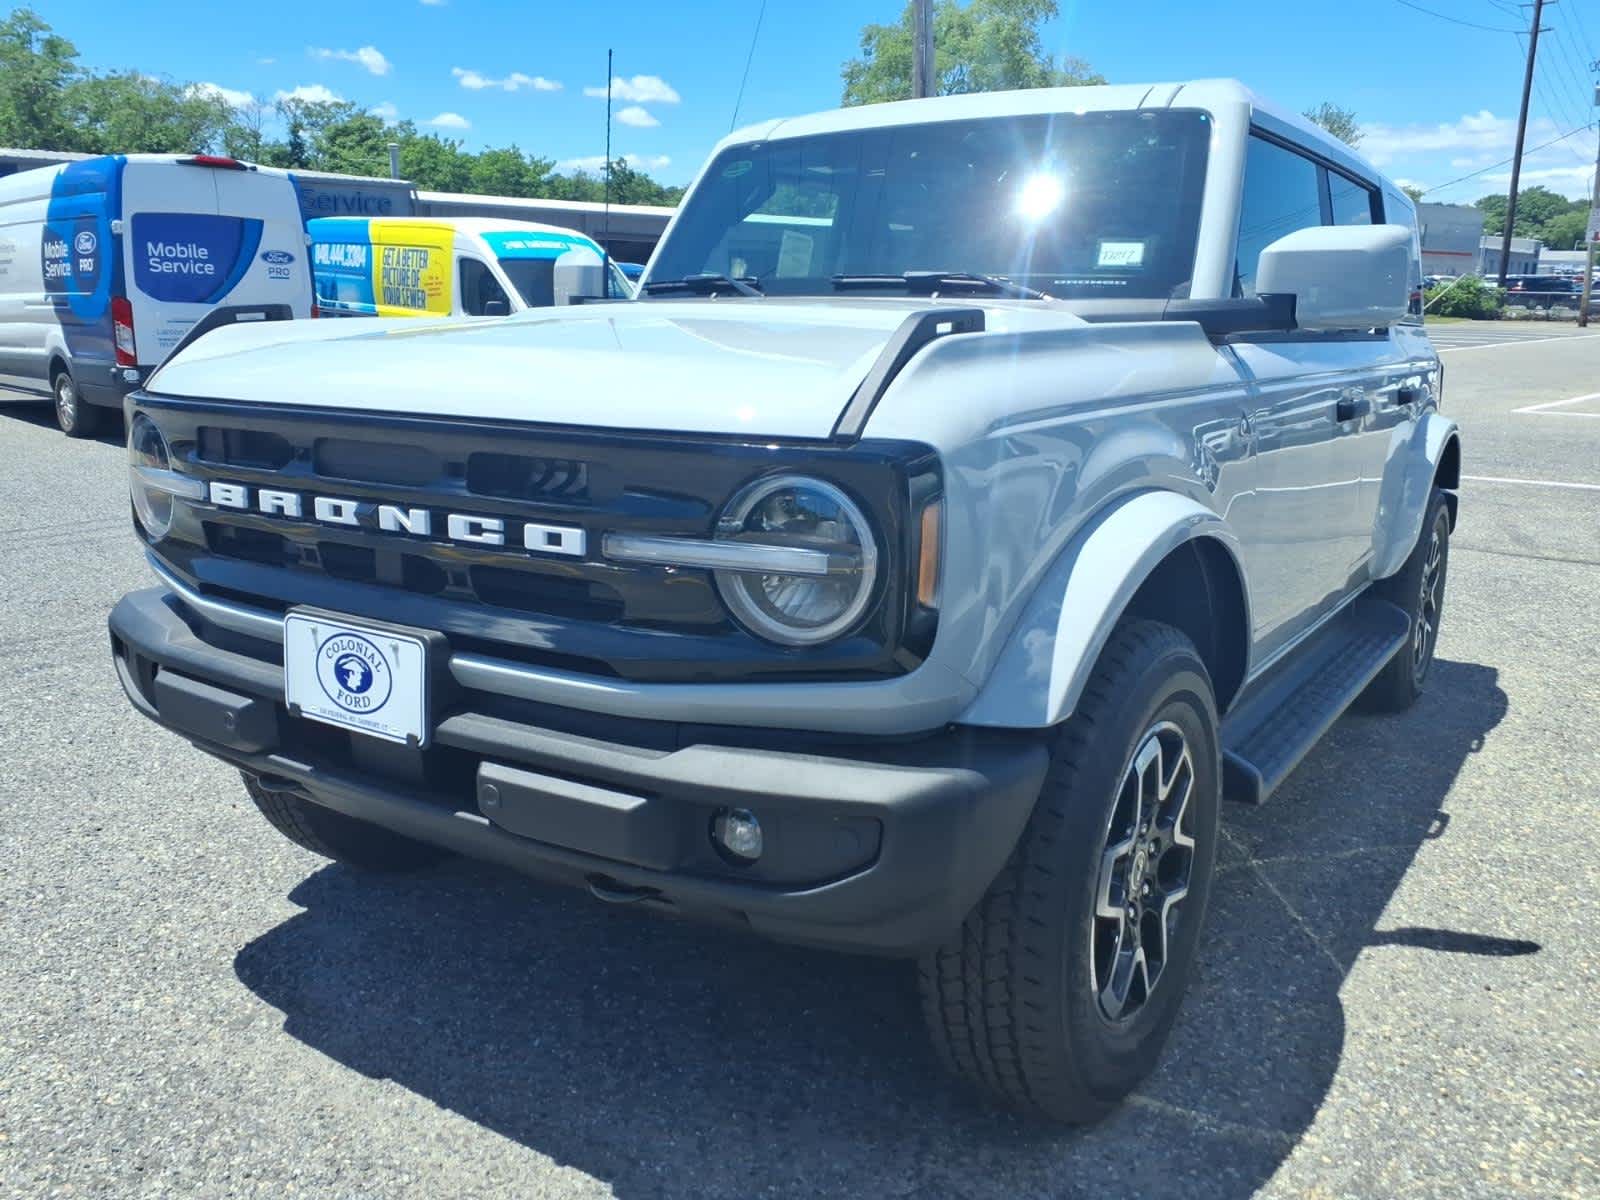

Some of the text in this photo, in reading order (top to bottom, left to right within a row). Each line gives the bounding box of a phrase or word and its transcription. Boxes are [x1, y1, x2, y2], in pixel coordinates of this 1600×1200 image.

[302, 188, 392, 214] Service
[44, 240, 69, 259] Mobile
[147, 242, 209, 260] Mobile
[383, 247, 429, 269] GET A BETTER
[45, 260, 71, 278] Service
[149, 258, 215, 275] Service
[268, 267, 290, 277] PRO
[383, 267, 410, 287] PICTURE
[411, 269, 421, 288] OF
[383, 286, 426, 309] YOUR SEWER
[209, 481, 587, 557] BRONCO
[326, 639, 382, 672] COLONIAL
[336, 689, 371, 709] FORD
